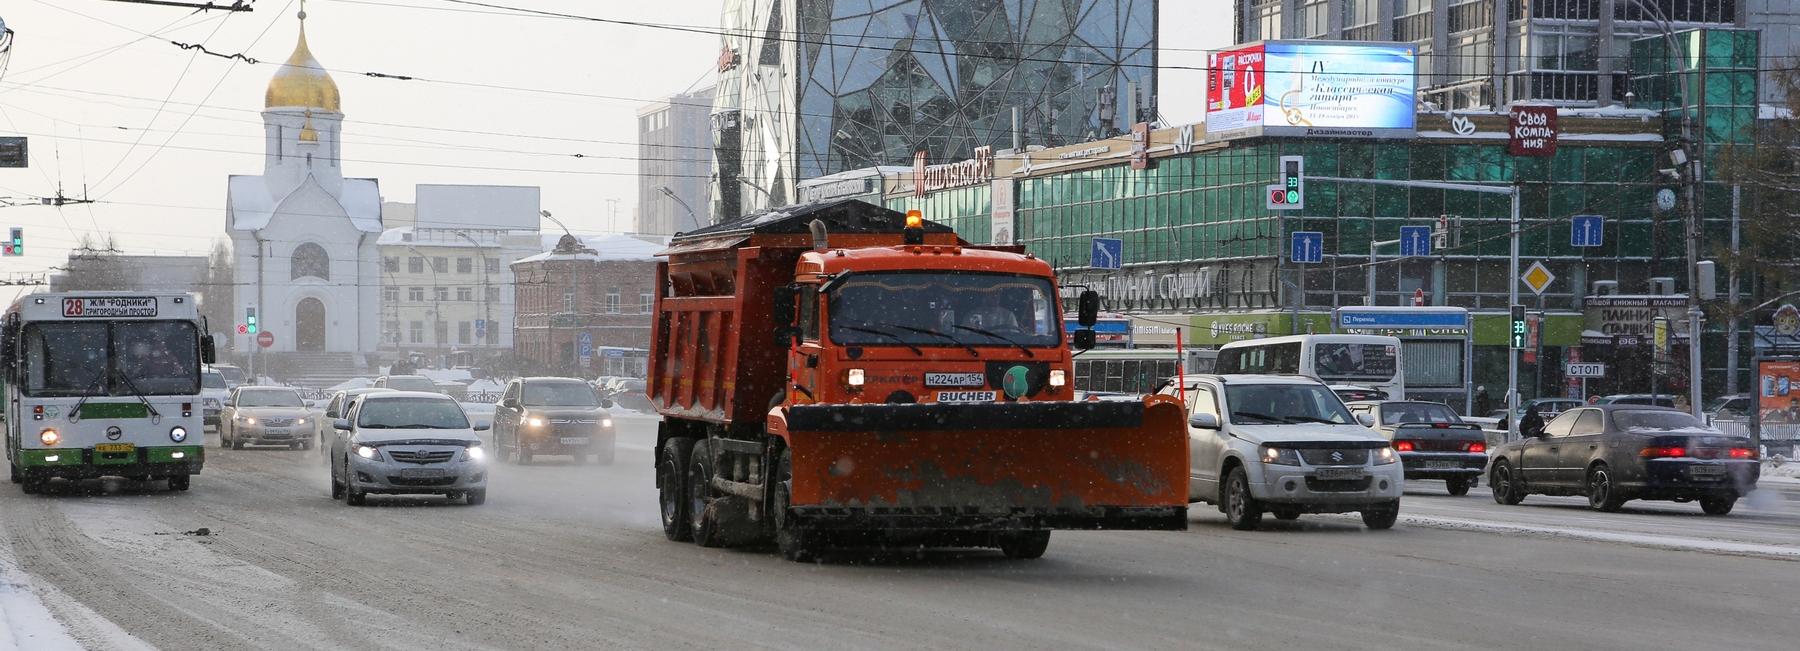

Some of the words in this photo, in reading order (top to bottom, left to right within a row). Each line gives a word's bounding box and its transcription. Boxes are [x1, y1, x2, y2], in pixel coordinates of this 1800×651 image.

[1306, 128, 1373, 137] Дизайнмастер
[1523, 139, 1543, 149] НИЯ
[1288, 177, 1298, 187] 33
[1159, 266, 1211, 299] СТАРШИЙ
[66, 300, 83, 315] 28
[86, 308, 128, 316] ПРИГОРОДНЫЙ
[129, 308, 155, 316] ПРОСТОР
[1234, 322, 1254, 334] ROCHE
[1514, 321, 1524, 333] 33
[1570, 365, 1599, 375] СТОП
[967, 374, 982, 382] 154
[939, 391, 993, 402] BUCHER
